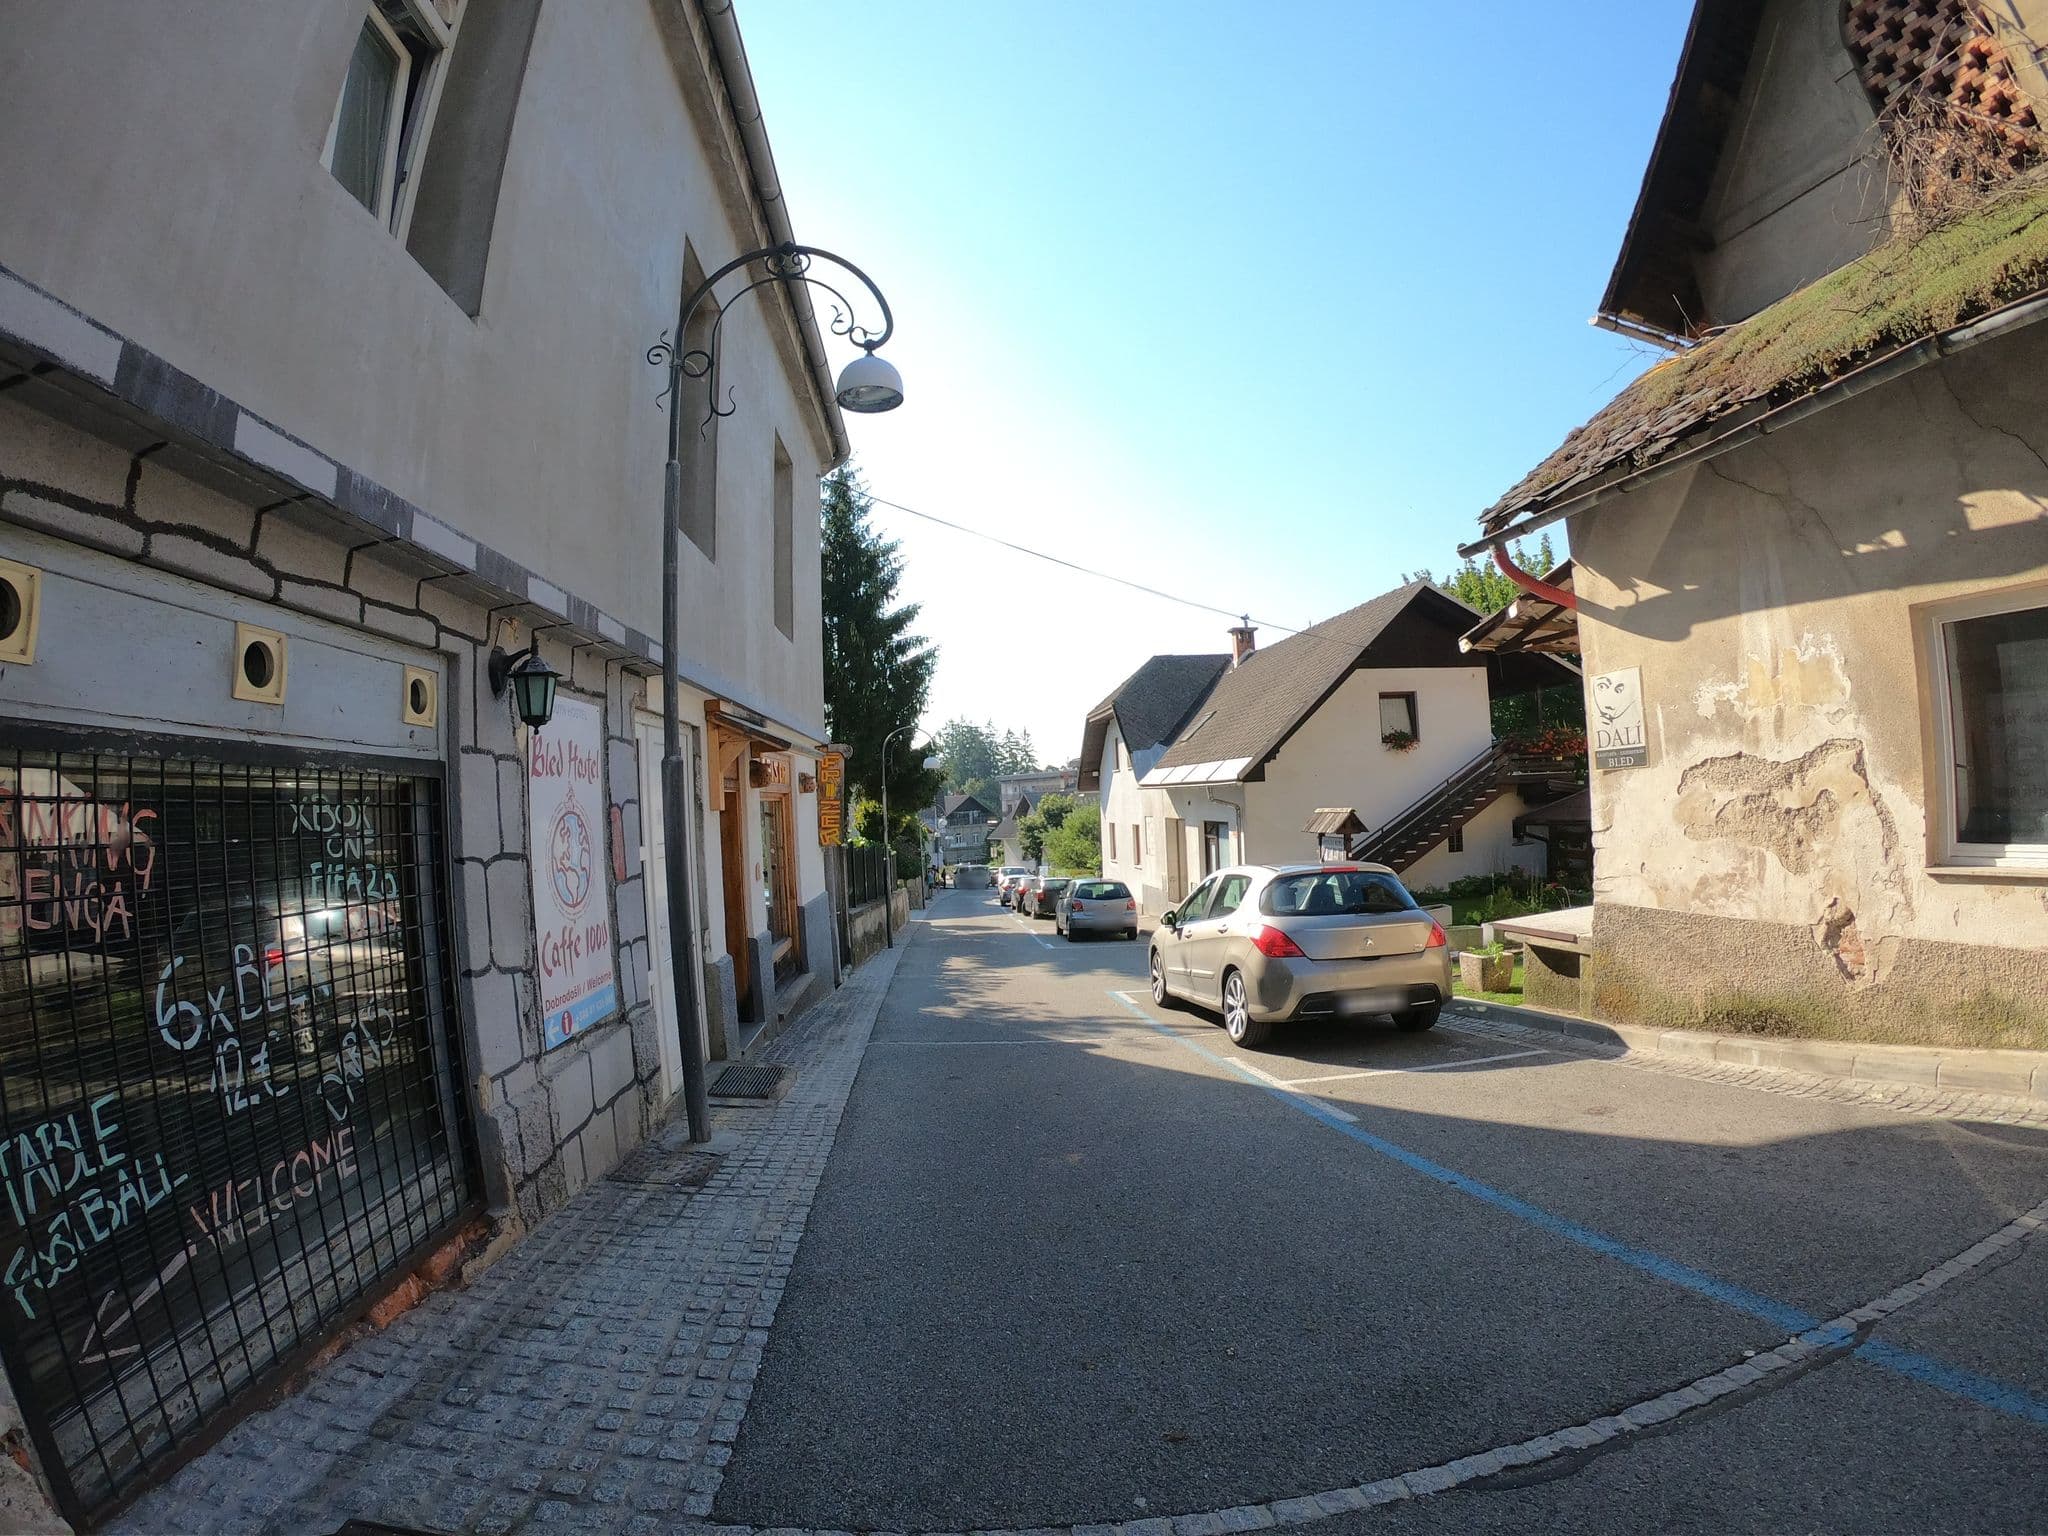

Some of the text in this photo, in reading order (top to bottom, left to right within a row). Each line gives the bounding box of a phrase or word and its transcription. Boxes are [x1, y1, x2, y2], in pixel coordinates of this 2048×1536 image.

[531, 734, 599, 785] Bled Hostel
[1596, 720, 1643, 749] DALÍ
[1608, 757, 1634, 768] BLED
[289, 793, 371, 835] XBOX
[820, 752, 842, 847] FRIZER
[542, 925, 581, 978] Caffe
[586, 970, 612, 991] Welcome
[0, 1091, 126, 1226] TABLE
[190, 1126, 357, 1254] WELCOME
